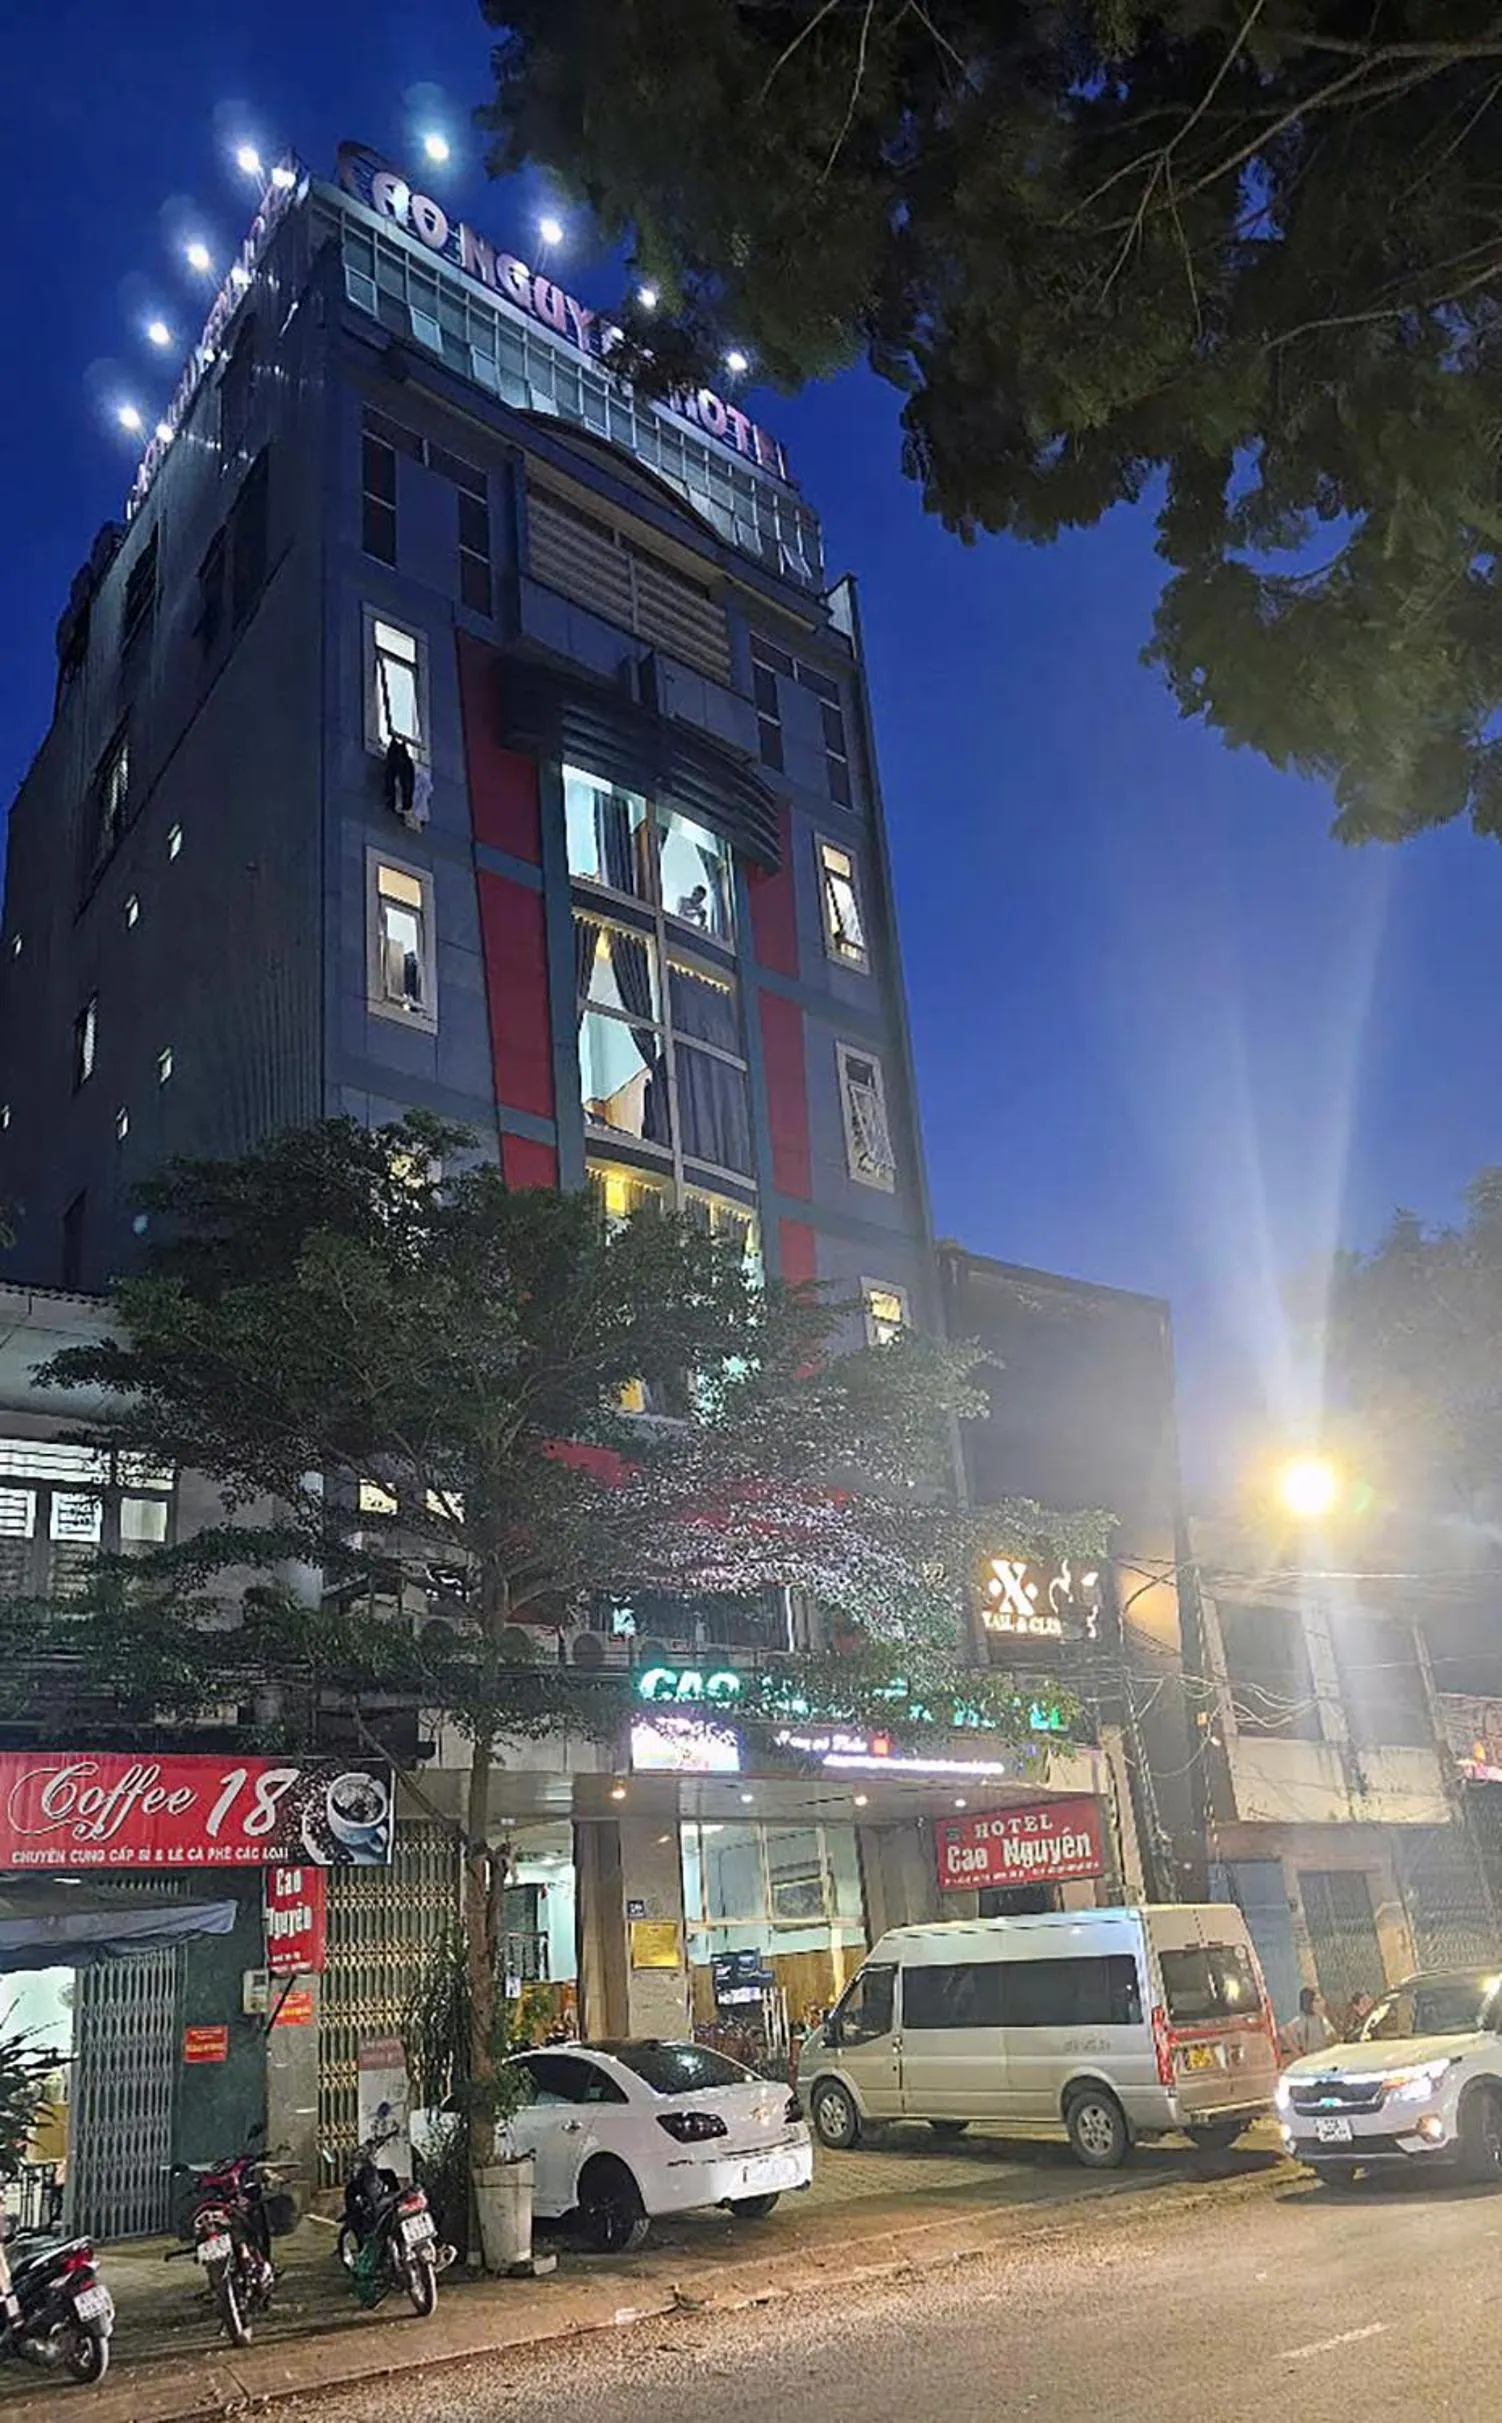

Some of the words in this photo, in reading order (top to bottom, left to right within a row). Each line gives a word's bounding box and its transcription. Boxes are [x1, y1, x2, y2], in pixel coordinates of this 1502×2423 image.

[639, 1668, 740, 1706] CAO
[8, 1761, 197, 1840] Coffee
[206, 1768, 300, 1837] 18
[975, 1814, 1053, 1839] HOTEL
[70, 1848, 105, 1864] CUNG
[207, 1845, 233, 1860] PHÊ
[947, 1845, 988, 1873] Cao
[276, 1868, 301, 1896] Cao
